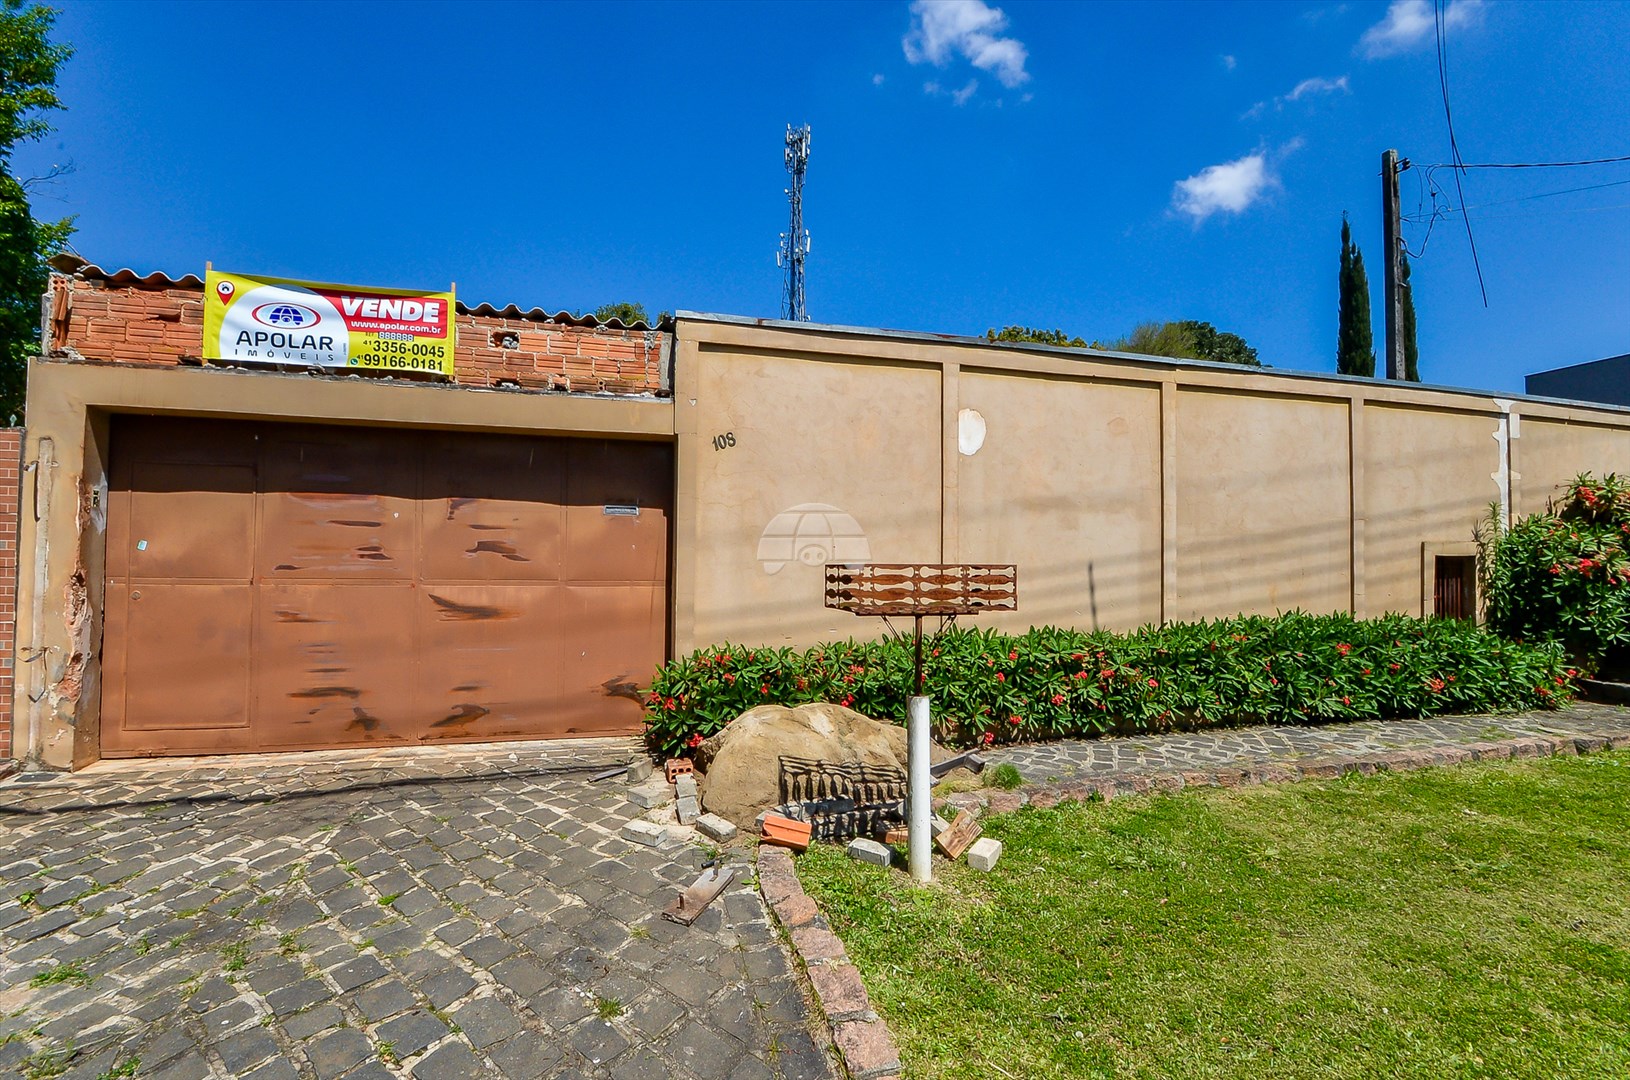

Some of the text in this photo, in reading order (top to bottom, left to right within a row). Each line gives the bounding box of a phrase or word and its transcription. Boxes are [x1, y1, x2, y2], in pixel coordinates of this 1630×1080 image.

[341, 296, 440, 323] VENDE
[351, 320, 441, 334] www.apolar.com.br
[236, 331, 333, 351] APOLAR
[712, 432, 736, 452] 108
